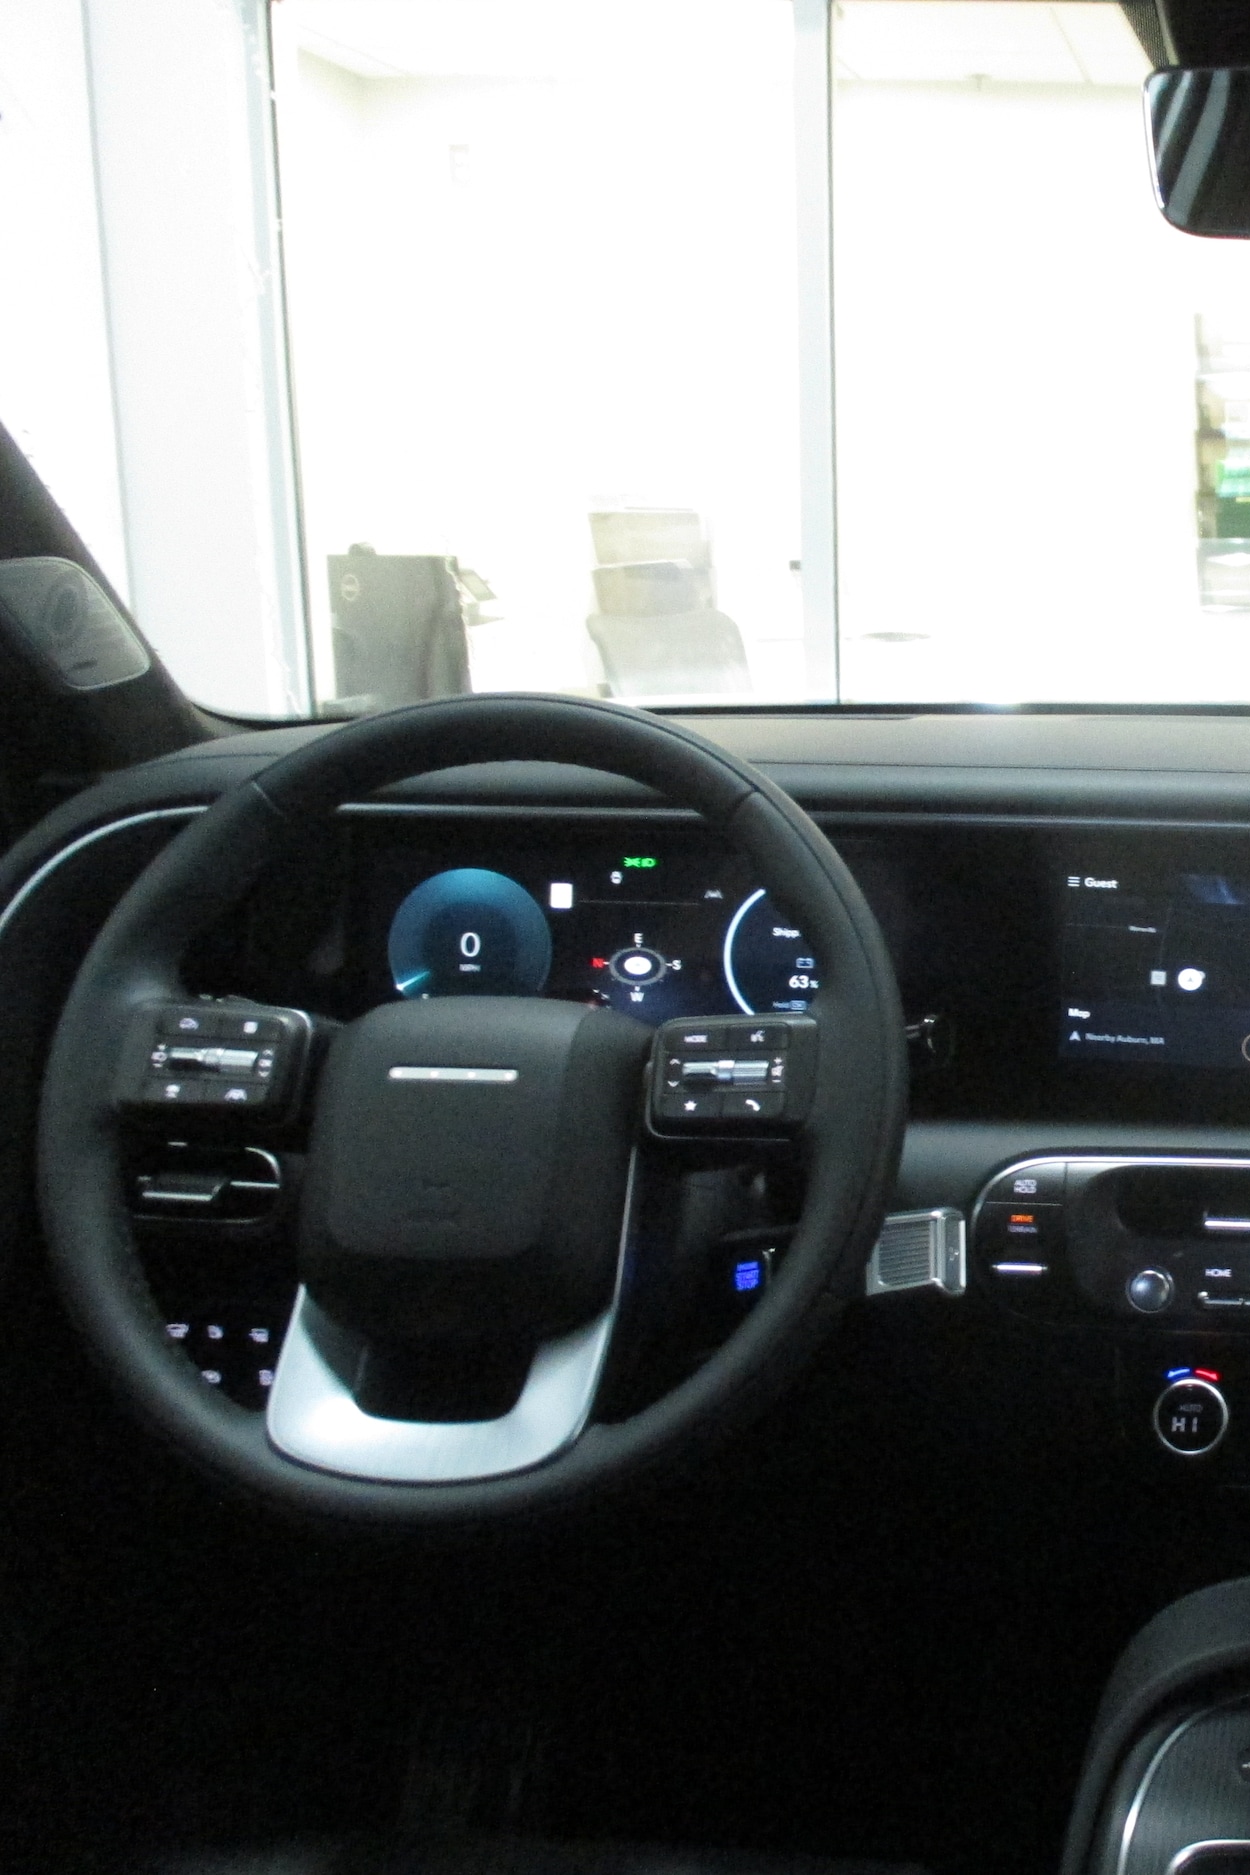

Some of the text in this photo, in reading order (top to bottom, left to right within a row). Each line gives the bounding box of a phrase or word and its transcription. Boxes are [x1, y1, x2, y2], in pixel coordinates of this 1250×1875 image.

[1084, 877, 1118, 890] Guest
[634, 932, 644, 944] E
[459, 932, 481, 957] 0
[671, 959, 682, 971] S
[630, 991, 645, 1002] W
[1068, 1008, 1091, 1019] Map
[1085, 1033, 1116, 1044] Nearby
[1010, 1214, 1034, 1223] DRIVE
[1204, 1268, 1232, 1278] HOME
